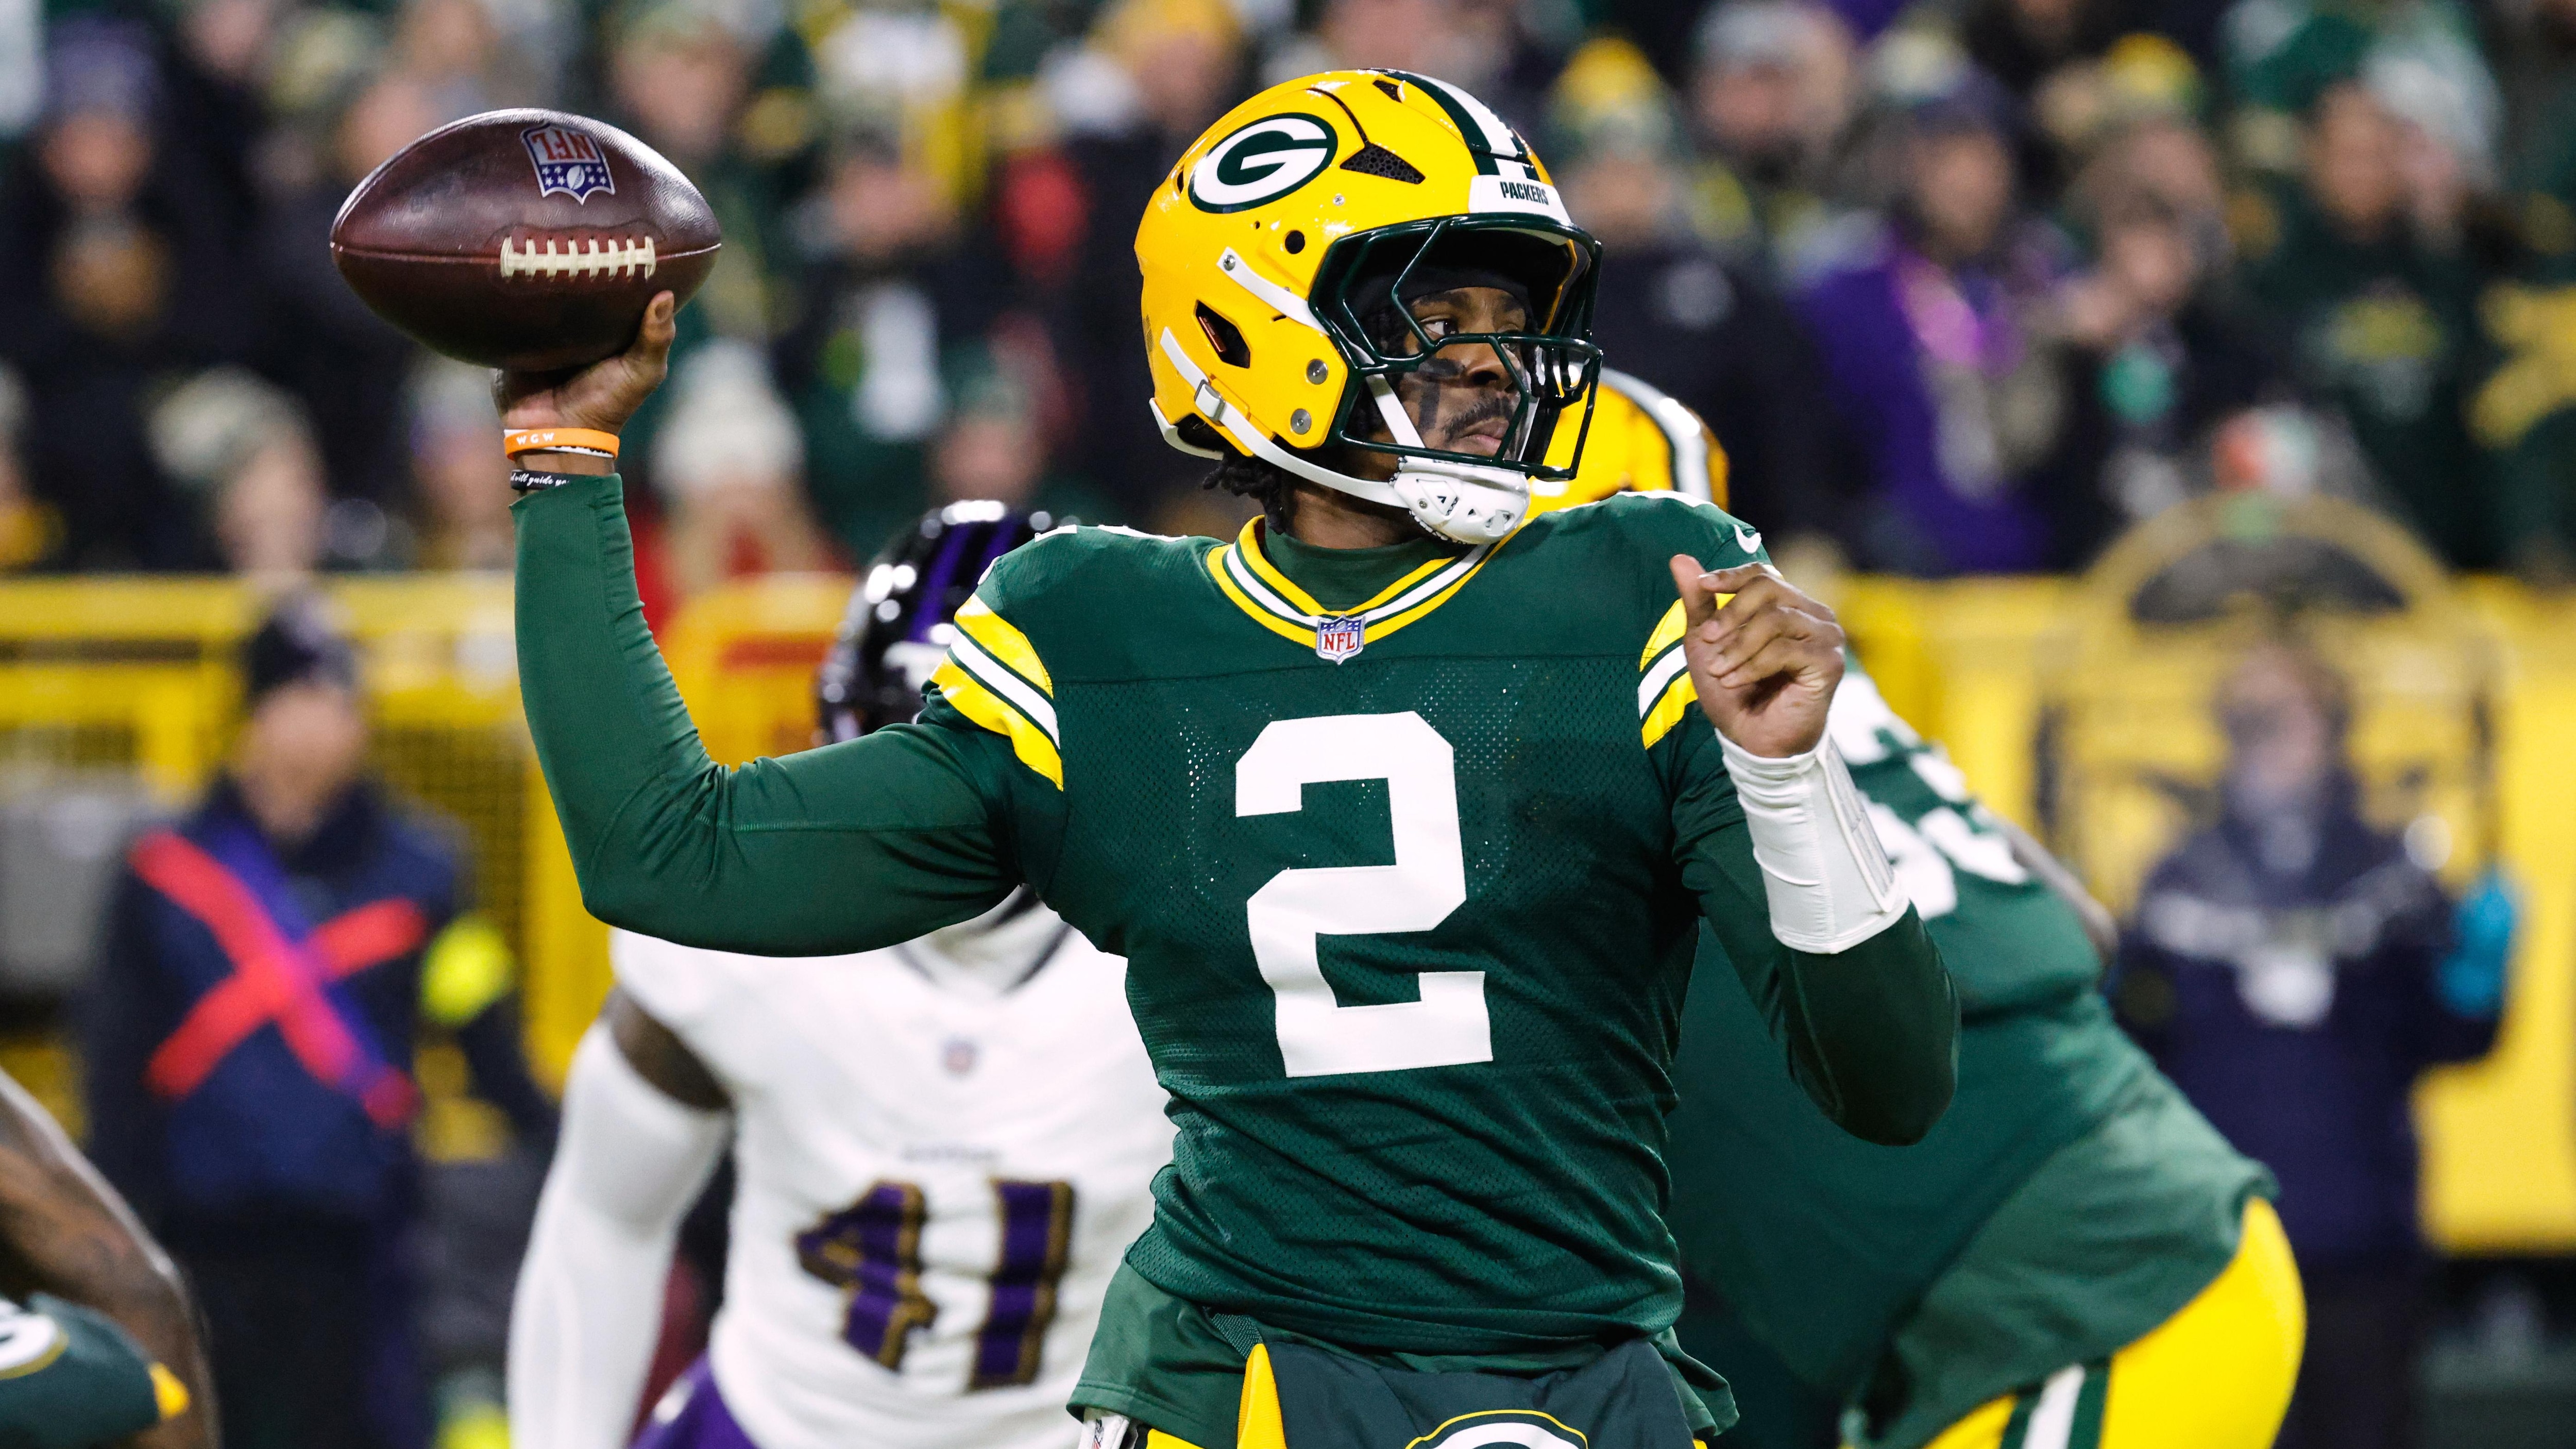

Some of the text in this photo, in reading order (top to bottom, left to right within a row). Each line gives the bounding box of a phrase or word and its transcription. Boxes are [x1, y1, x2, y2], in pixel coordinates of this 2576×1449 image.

[532, 129, 596, 160] NFL
[1500, 181, 1549, 205] PACKERS
[527, 475, 553, 486] guide
[1324, 632, 1355, 652] NFL
[1236, 711, 1494, 1077] 2
[794, 1177, 1075, 1390] 41
